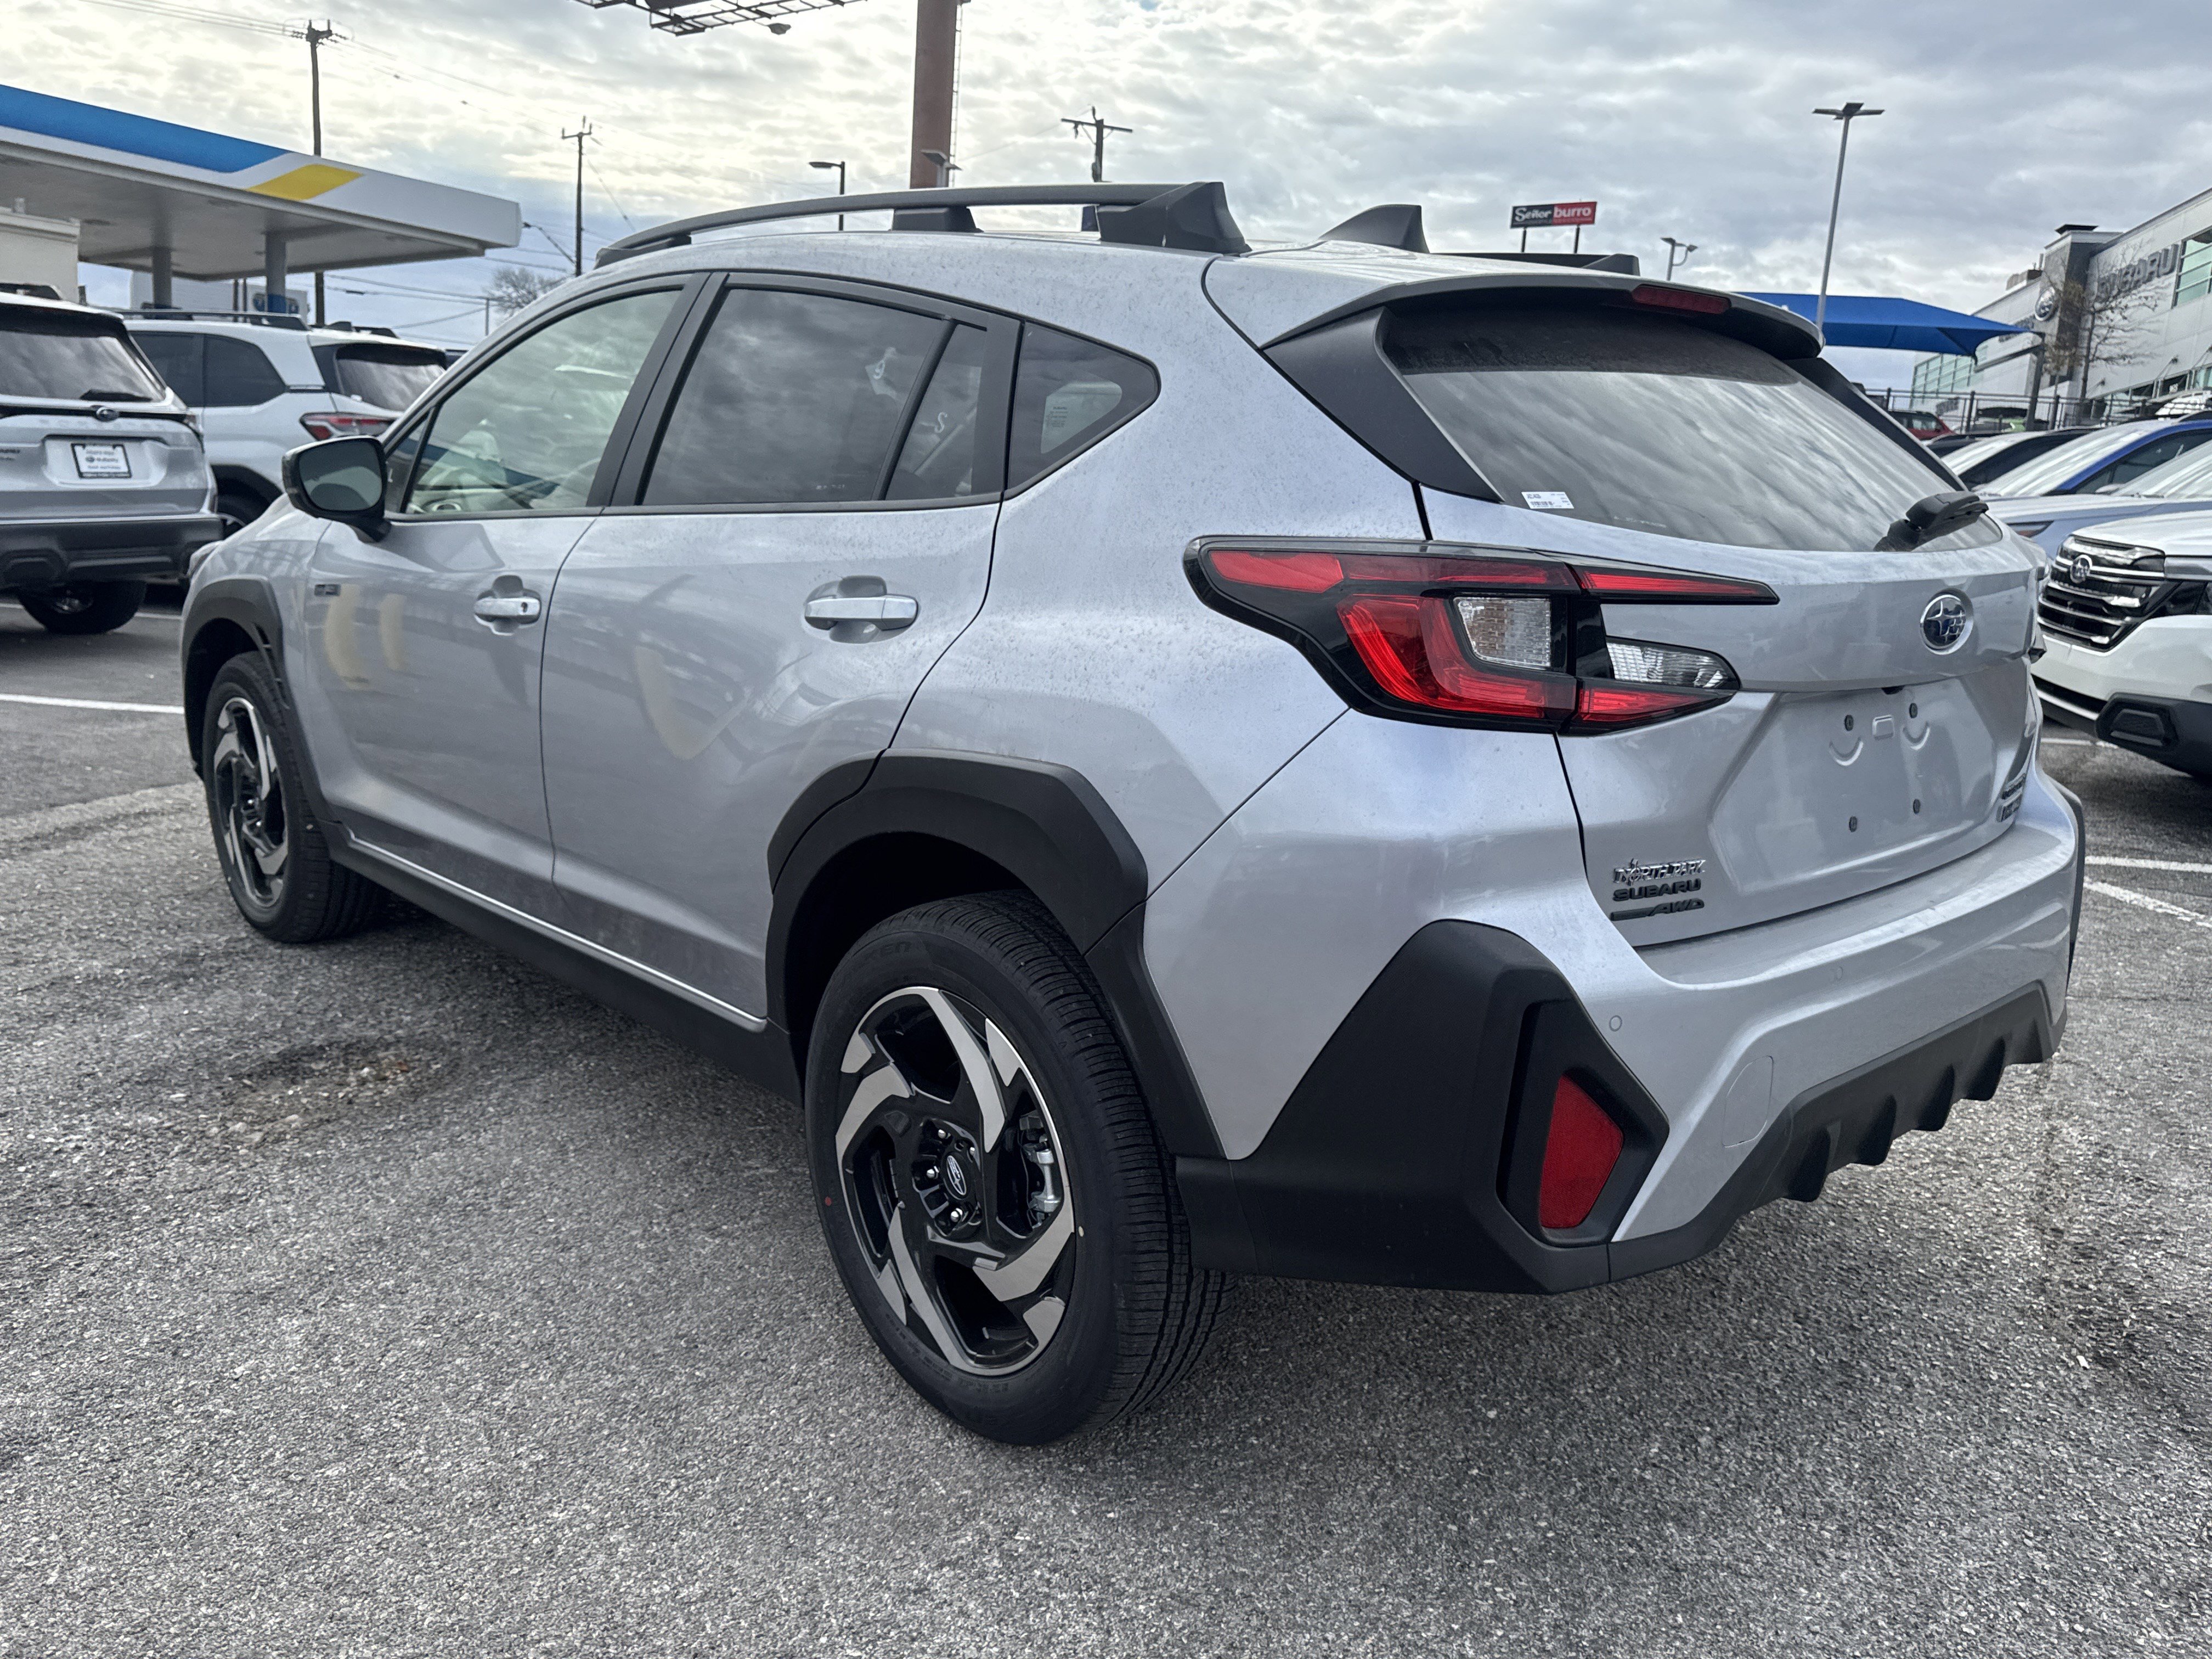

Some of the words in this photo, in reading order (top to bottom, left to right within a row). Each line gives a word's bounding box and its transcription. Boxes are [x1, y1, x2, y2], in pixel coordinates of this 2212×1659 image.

[1554, 206, 1591, 218] burro
[1613, 878, 1701, 902] SUBARU
[1647, 898, 1705, 917] AWD
